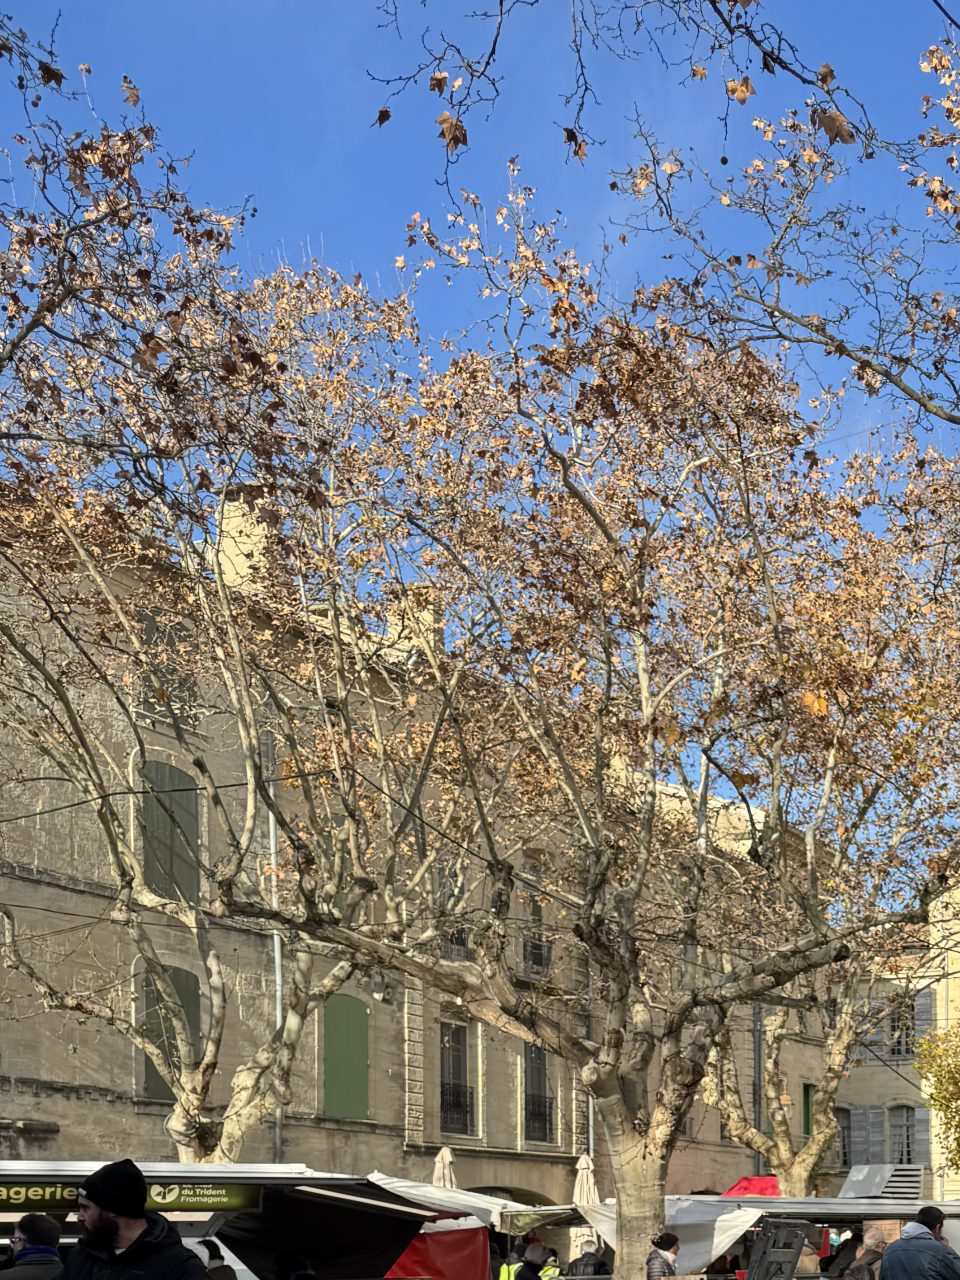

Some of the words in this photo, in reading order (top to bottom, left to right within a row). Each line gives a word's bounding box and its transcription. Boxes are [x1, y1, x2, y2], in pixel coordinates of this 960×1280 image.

[182, 1188, 194, 1196] du
[195, 1188, 226, 1196] Trident
[181, 1195, 228, 1204] Fromagerie
